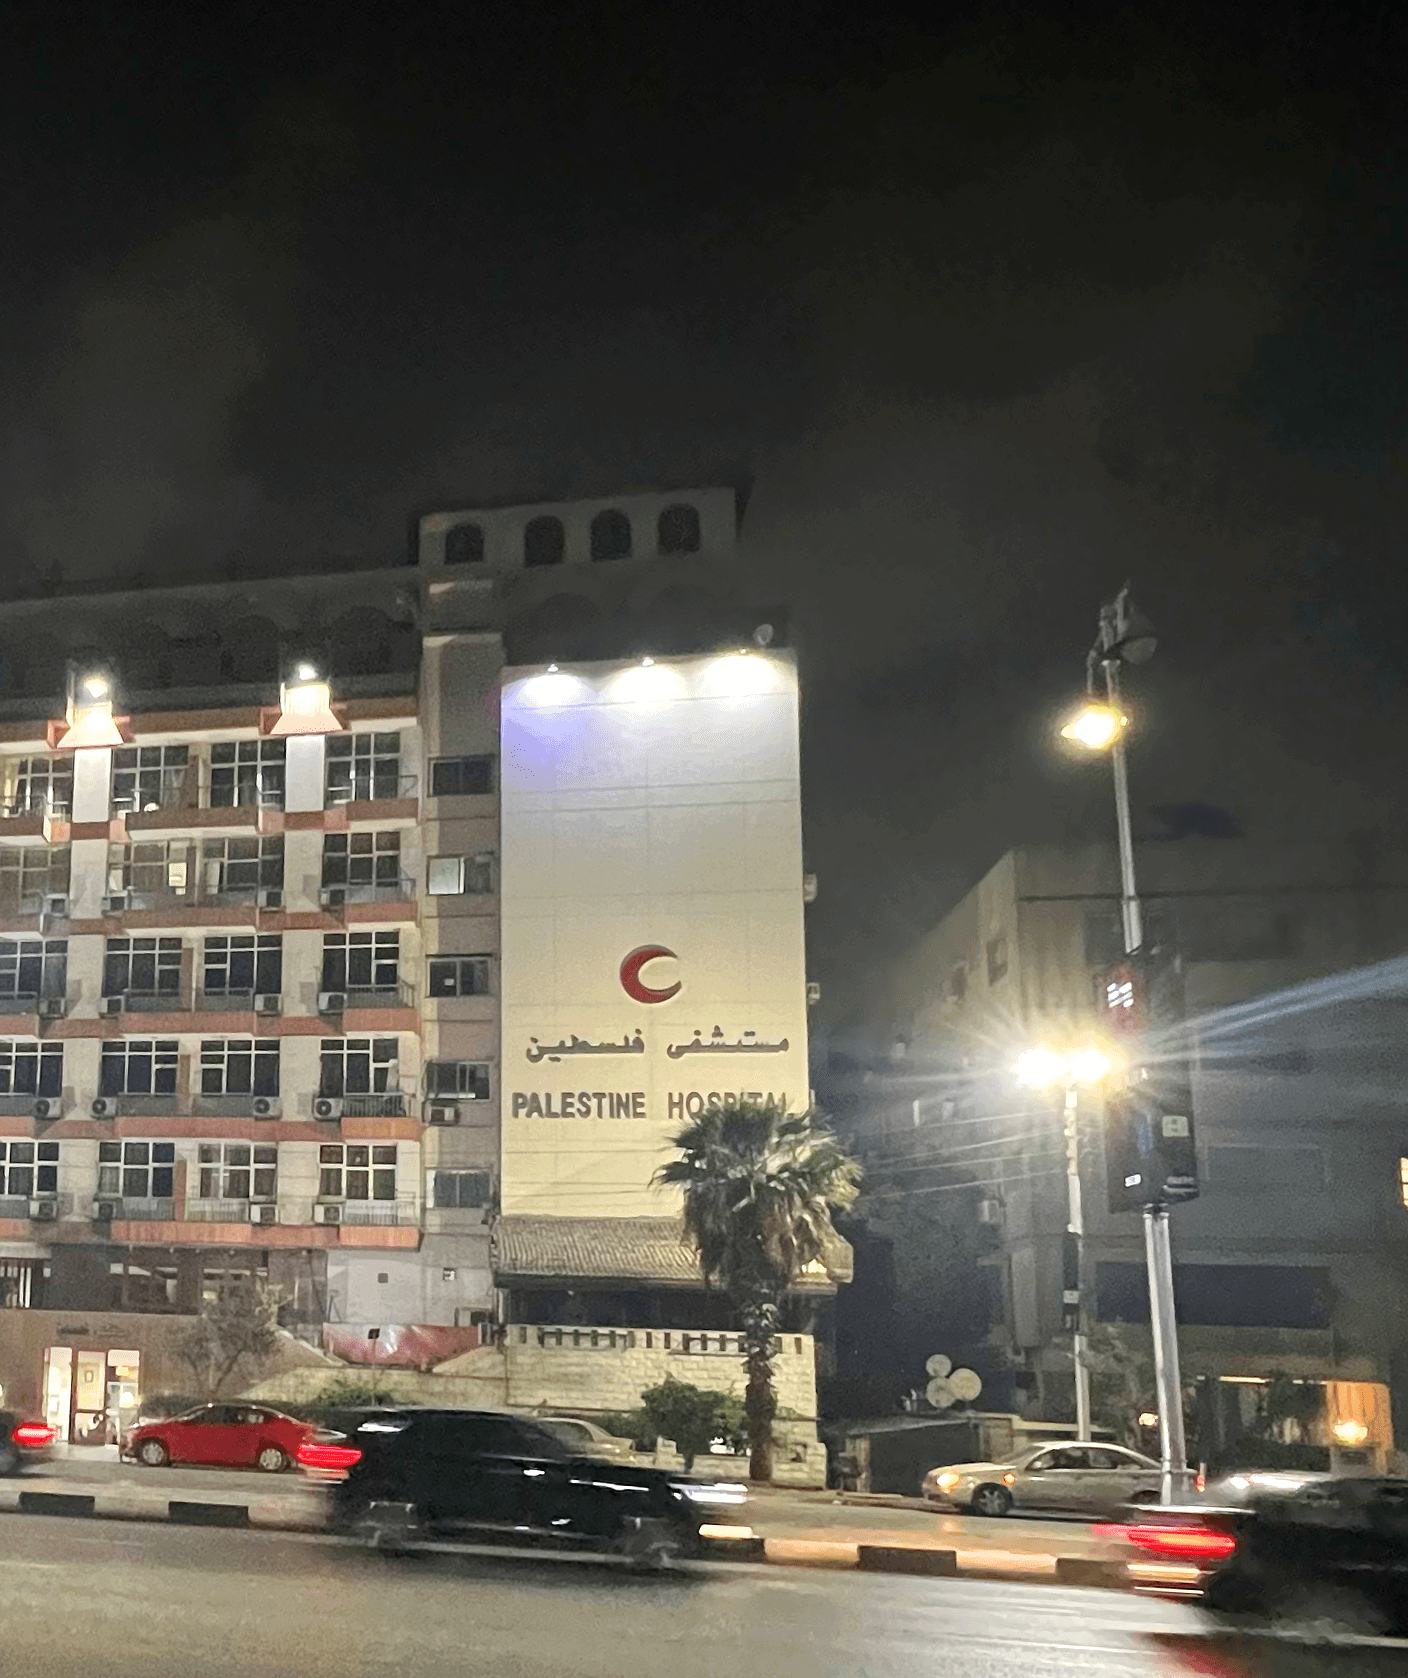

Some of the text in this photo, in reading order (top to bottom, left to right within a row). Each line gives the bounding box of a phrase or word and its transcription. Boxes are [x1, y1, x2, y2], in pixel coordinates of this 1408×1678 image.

[526, 1024, 789, 1063] مستشفى فلسطين
[511, 1091, 646, 1119] PALESTINE
